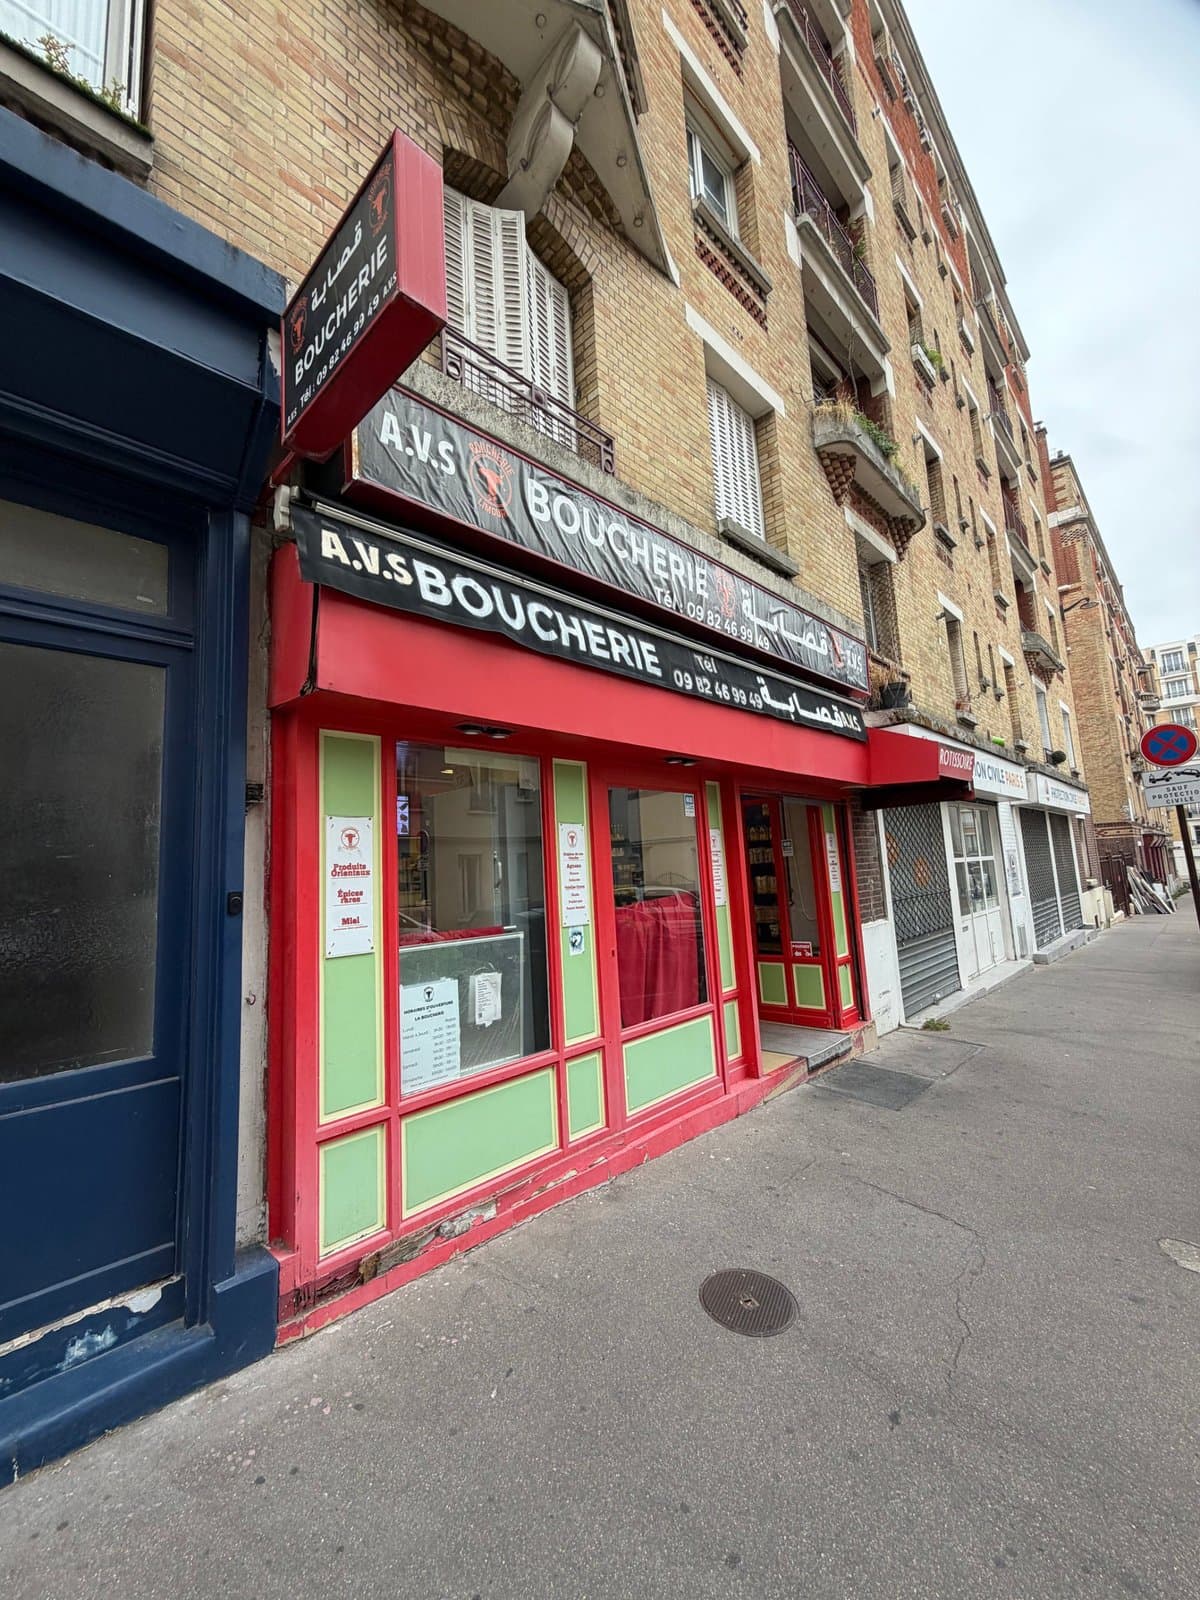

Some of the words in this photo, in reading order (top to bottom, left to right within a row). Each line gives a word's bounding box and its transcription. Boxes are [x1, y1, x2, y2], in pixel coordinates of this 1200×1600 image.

[311, 220, 362, 311] قصابة
[294, 235, 388, 385] BOUCHERIE
[316, 365, 328, 386] 09
[329, 348, 340, 370] 82
[340, 331, 352, 352] 46
[353, 312, 365, 336] 99
[367, 294, 379, 316] 49
[379, 410, 456, 476] A.V.S
[526, 478, 709, 599] BOUCHERIE
[320, 528, 413, 586] A.V.S
[412, 558, 663, 678] BOUCHERIE
[741, 588, 829, 656] قصابة
[686, 601, 705, 620] 09
[706, 610, 722, 630] 82
[724, 621, 738, 637] 46
[740, 626, 753, 644] 99
[758, 634, 770, 651] 49
[693, 652, 718, 674] Tél
[673, 669, 693, 690] 09
[714, 681, 731, 701] 46
[731, 686, 747, 706] 99
[748, 691, 763, 709] 49
[756, 675, 844, 728] قصابة
[939, 748, 974, 771] ROTISSOIRE
[987, 764, 1005, 785] CIVILE
[1152, 789, 1200, 800] PROTECTIO
[1165, 796, 1194, 805] CIVILE
[1166, 784, 1188, 793] SAUF
[330, 869, 370, 878] Orientaux
[333, 863, 366, 871] Produits
[341, 916, 360, 926] Miel
